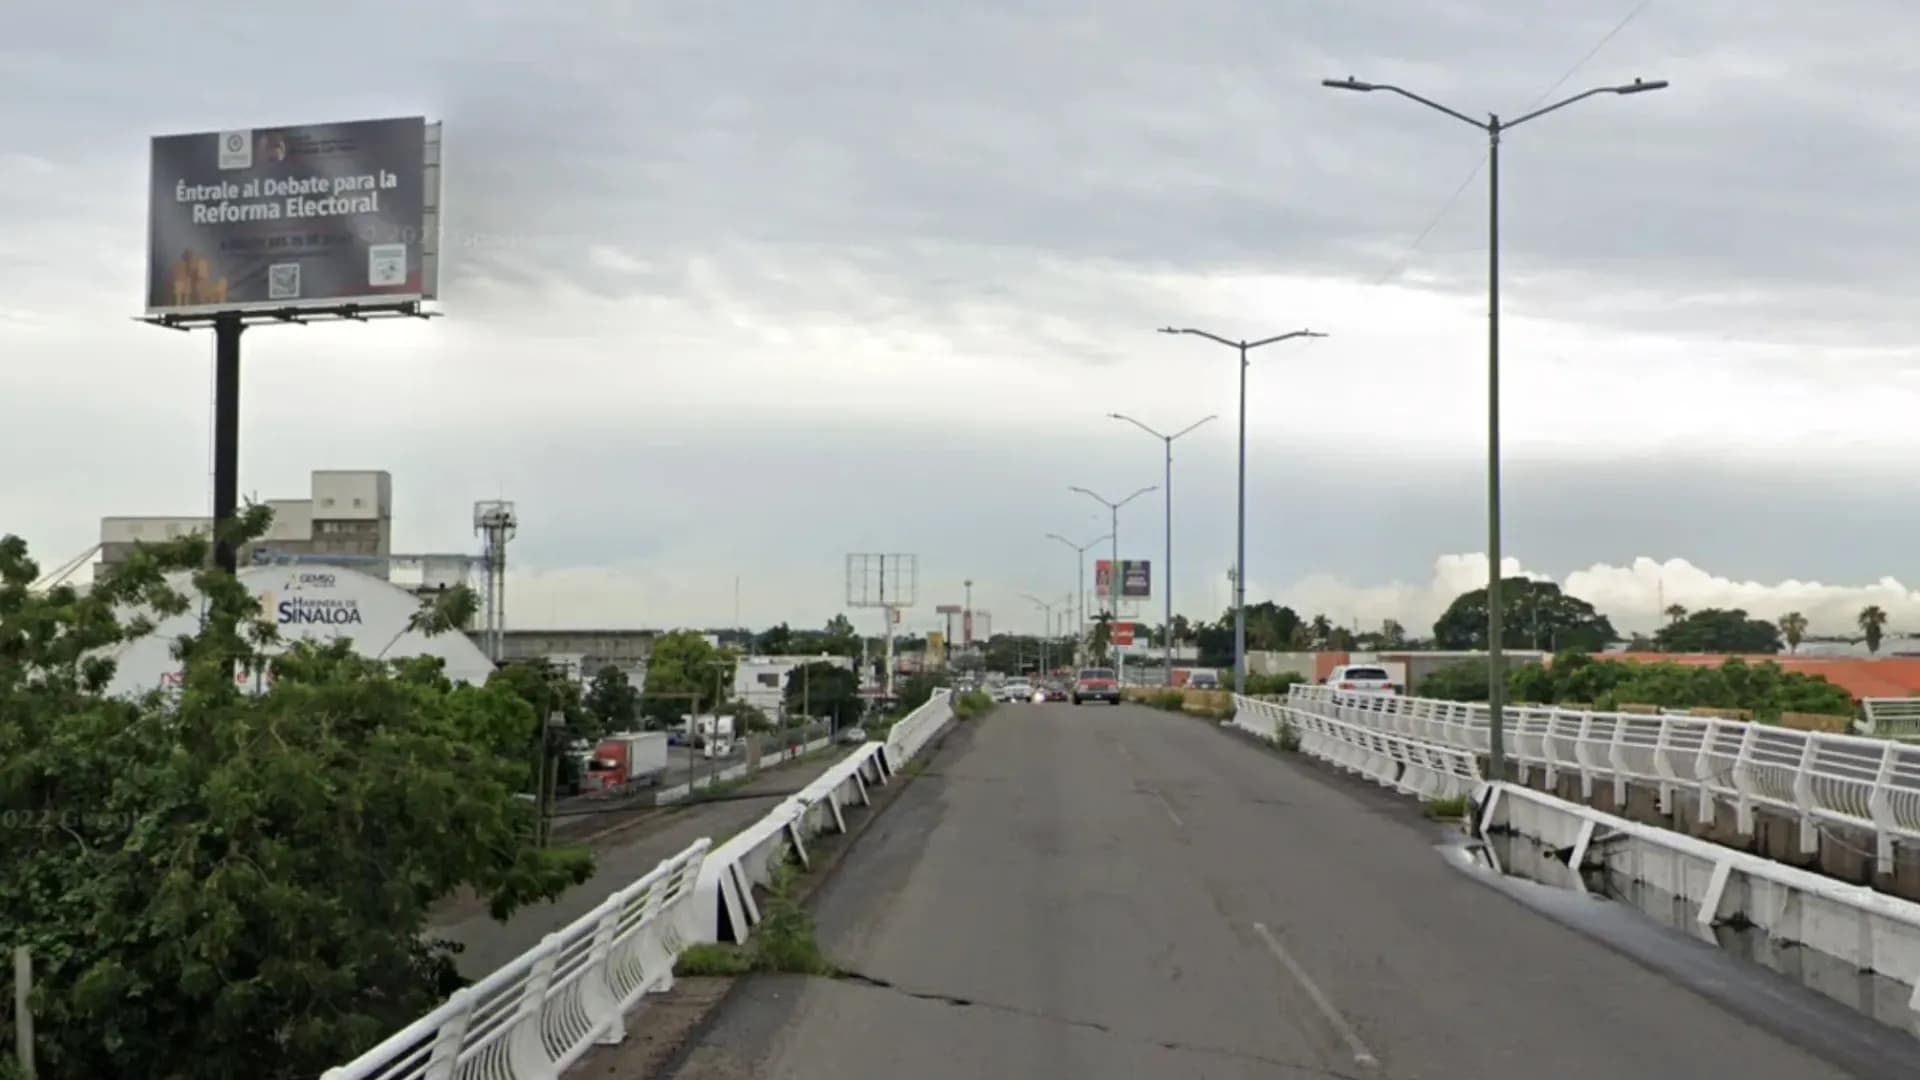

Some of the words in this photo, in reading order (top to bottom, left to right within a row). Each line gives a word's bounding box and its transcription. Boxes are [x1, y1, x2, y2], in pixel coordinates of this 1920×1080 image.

[176, 179, 238, 202] Éntrale
[243, 178, 259, 198] al
[264, 177, 329, 196] Debate
[333, 175, 374, 194] para
[379, 169, 397, 189] la
[193, 201, 281, 223] Reforma
[286, 191, 379, 218] Electoral
[278, 602, 361, 623] SINALOA
